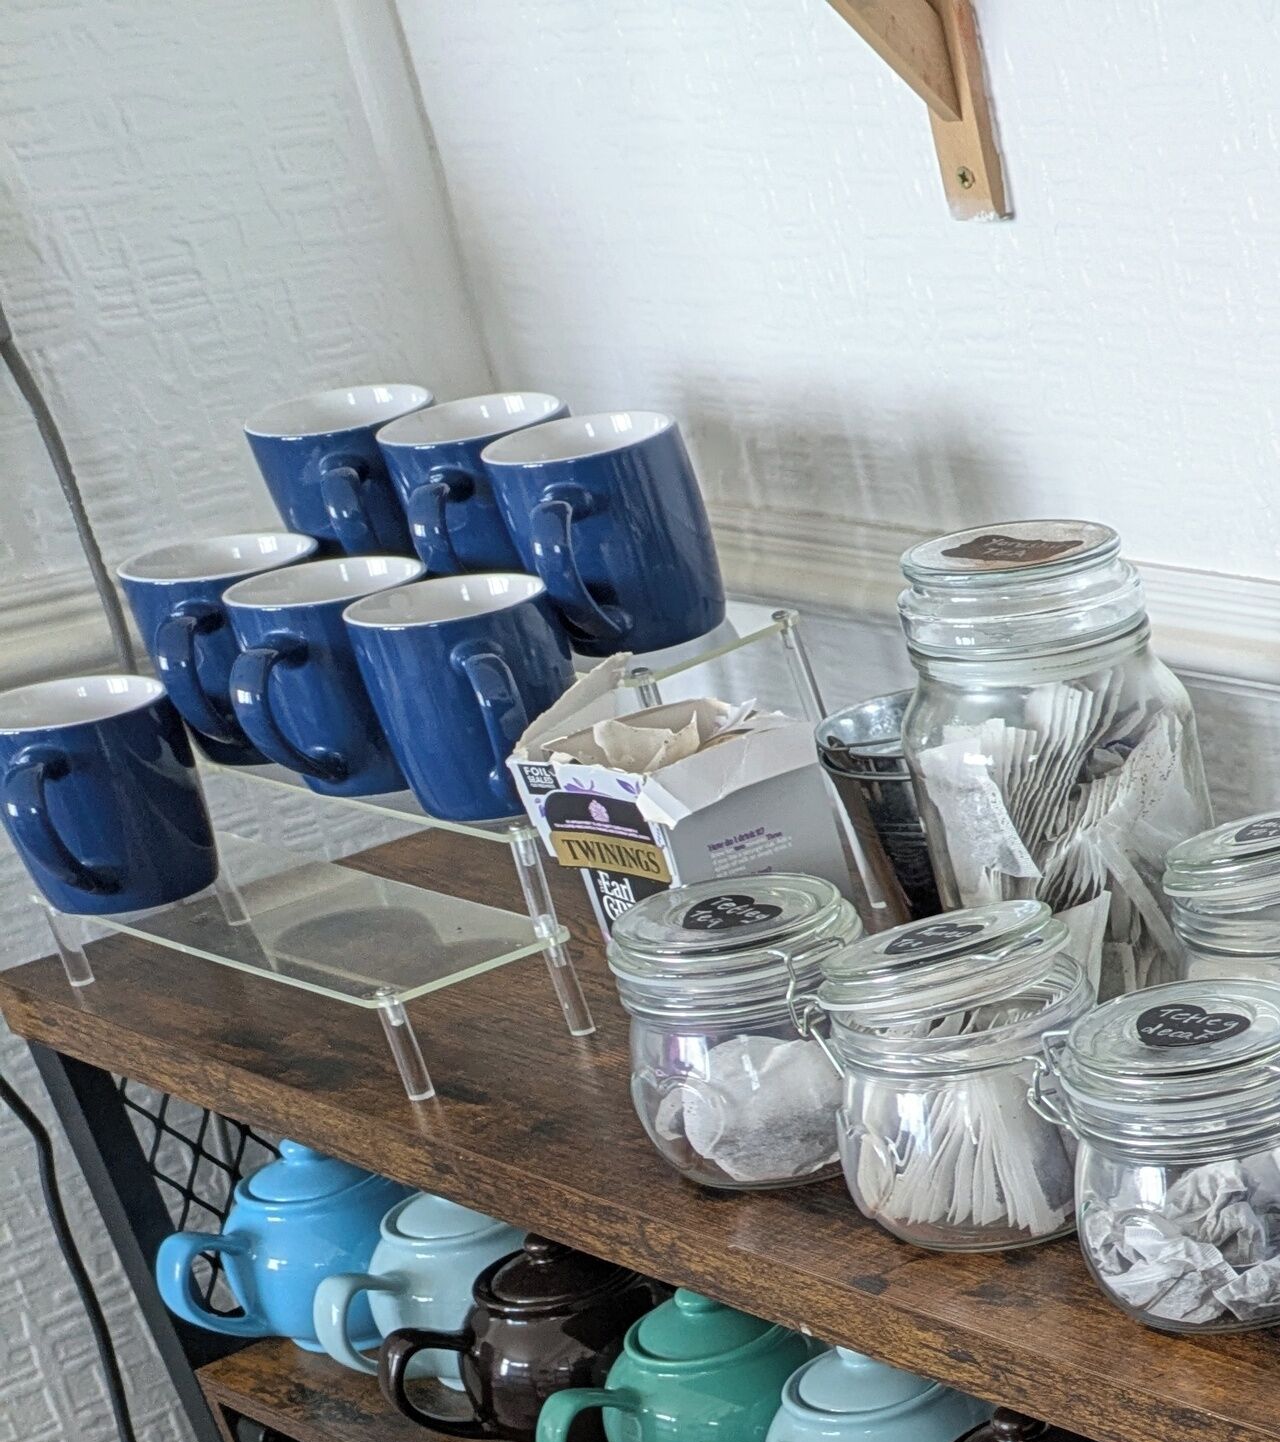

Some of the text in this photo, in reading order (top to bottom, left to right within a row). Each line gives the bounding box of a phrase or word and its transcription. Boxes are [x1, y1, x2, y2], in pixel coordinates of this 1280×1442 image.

[523, 766, 551, 777] FOIL
[561, 838, 661, 875] TWININGS
[597, 870, 636, 904] Earl
